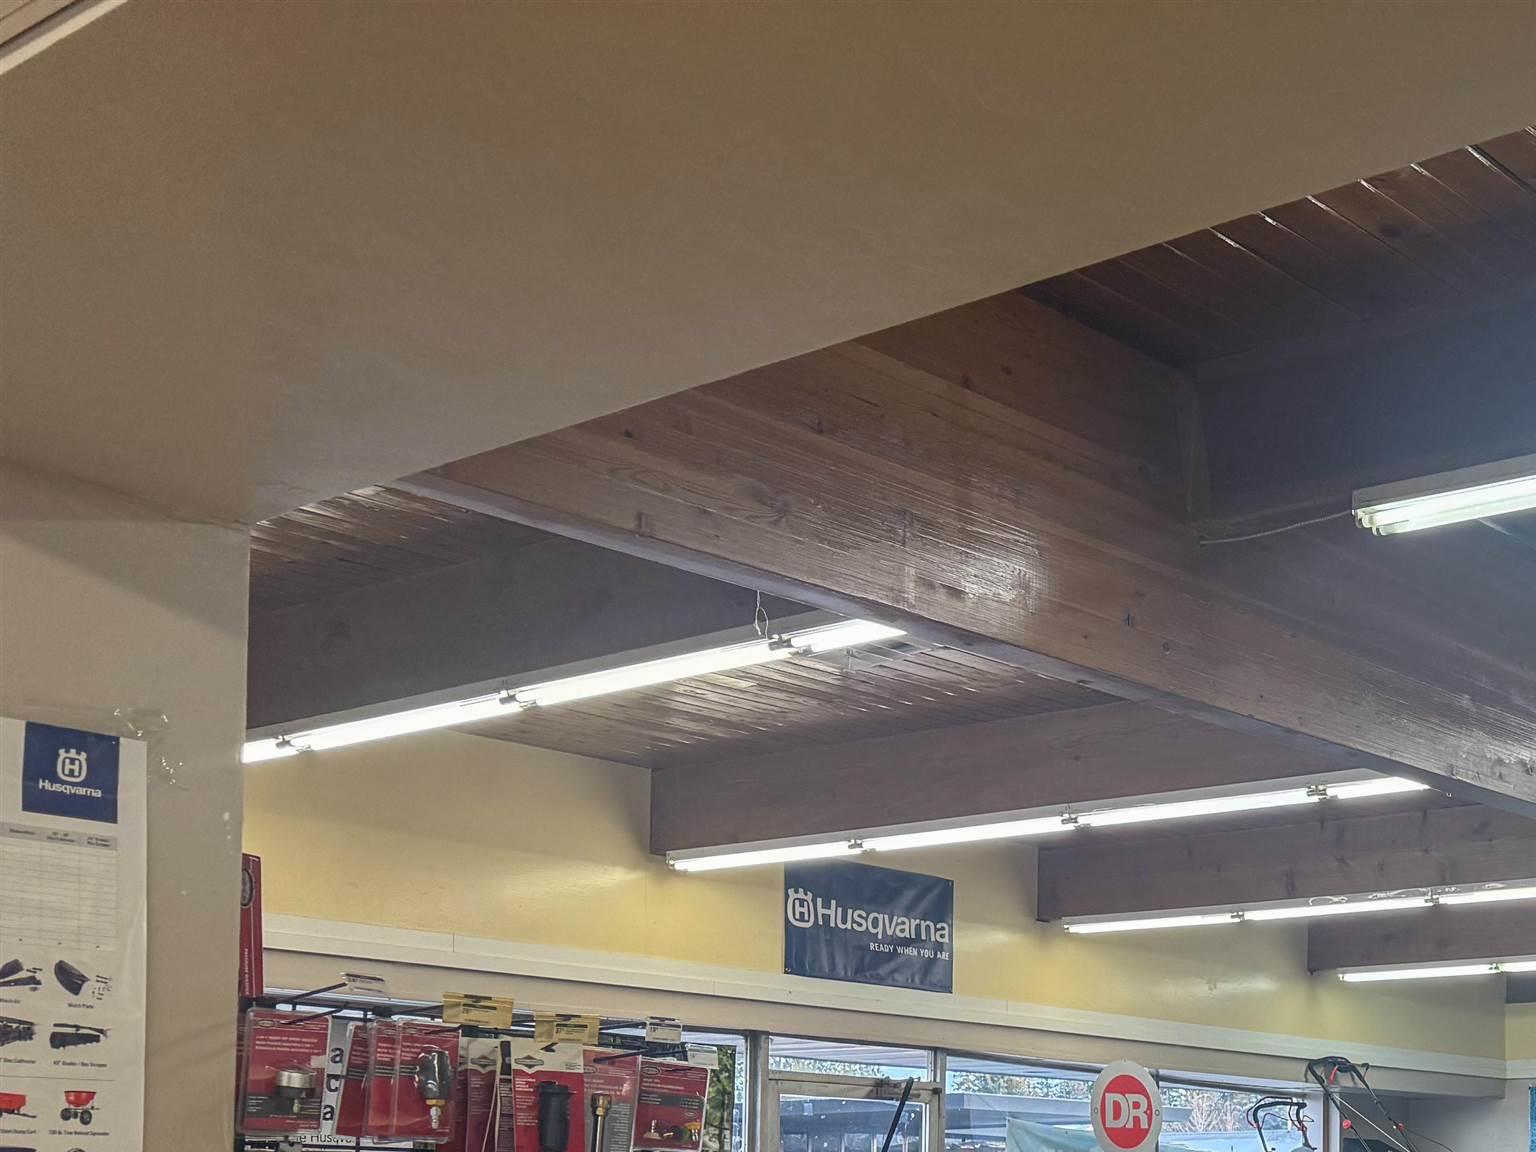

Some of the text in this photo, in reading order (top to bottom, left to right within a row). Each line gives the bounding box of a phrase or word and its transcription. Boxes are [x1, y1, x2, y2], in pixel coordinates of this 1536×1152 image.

[39, 778, 102, 798] Husqvarna
[816, 897, 950, 943] Husqvarna
[870, 942, 949, 961] READY WHEN YOU ARE
[1105, 1092, 1149, 1129] DR
